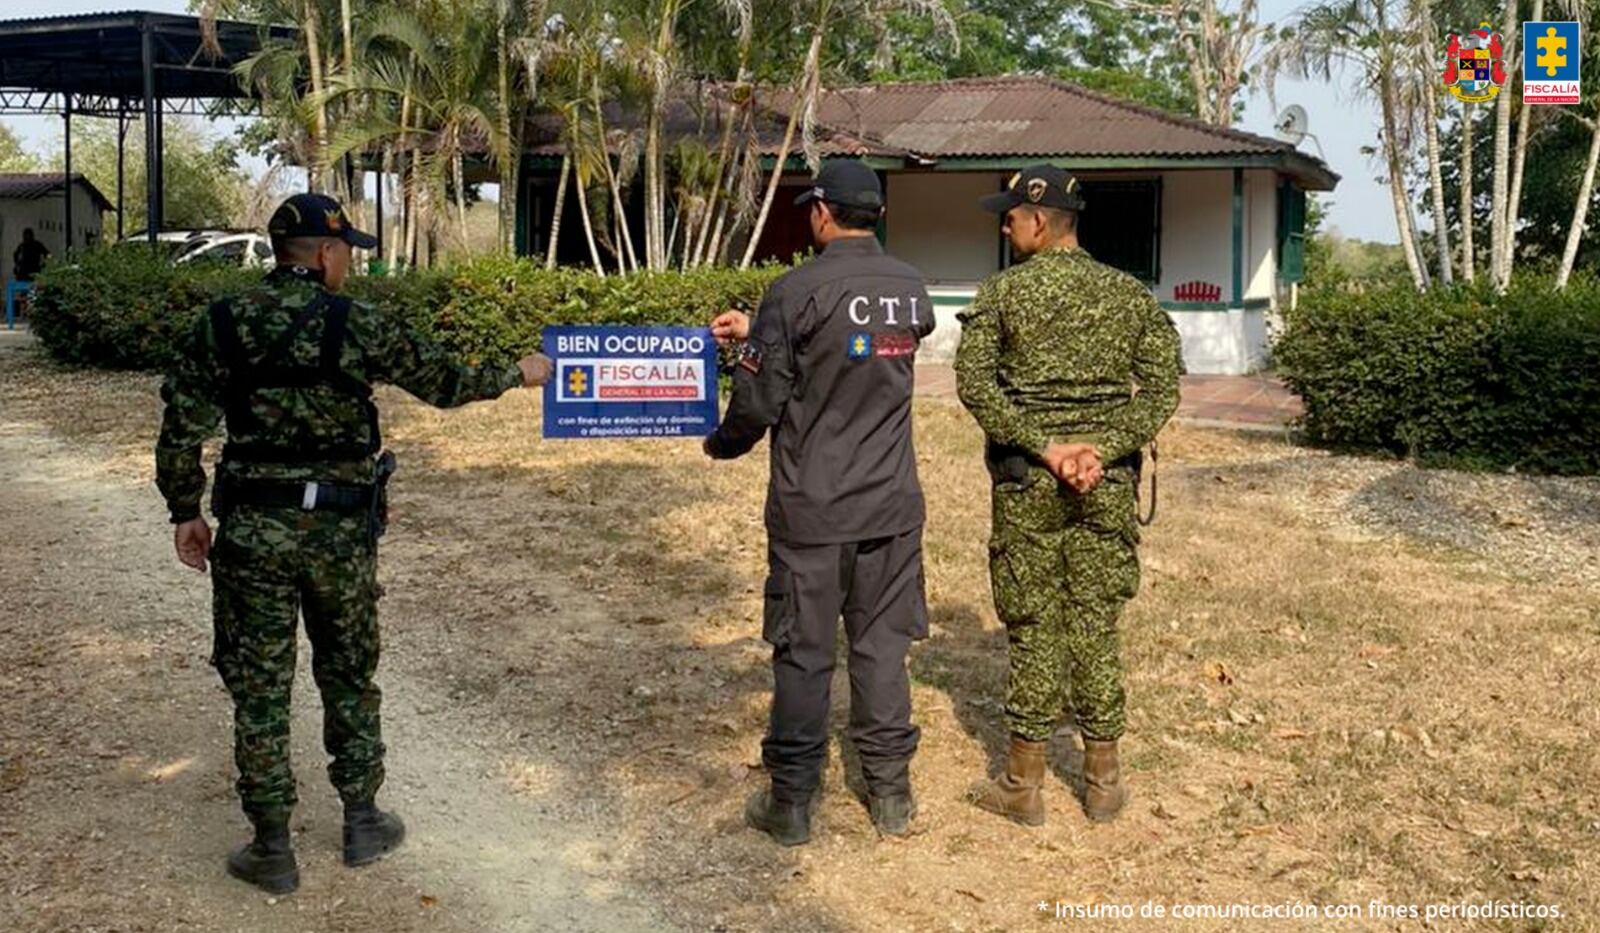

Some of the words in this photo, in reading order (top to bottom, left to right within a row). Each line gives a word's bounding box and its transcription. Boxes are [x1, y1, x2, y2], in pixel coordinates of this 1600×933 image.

[557, 336, 599, 352] BIEN
[605, 336, 704, 353] OCUPADO
[600, 362, 697, 380] FISCALÍA
[602, 387, 640, 397] GENERAL
[641, 387, 652, 397] DE
[578, 417, 598, 425] fines
[600, 417, 611, 425] de
[614, 416, 654, 425] extinción
[656, 416, 668, 424] de
[589, 426, 639, 437] disposición
[640, 427, 652, 436] de
[654, 427, 663, 436] la
